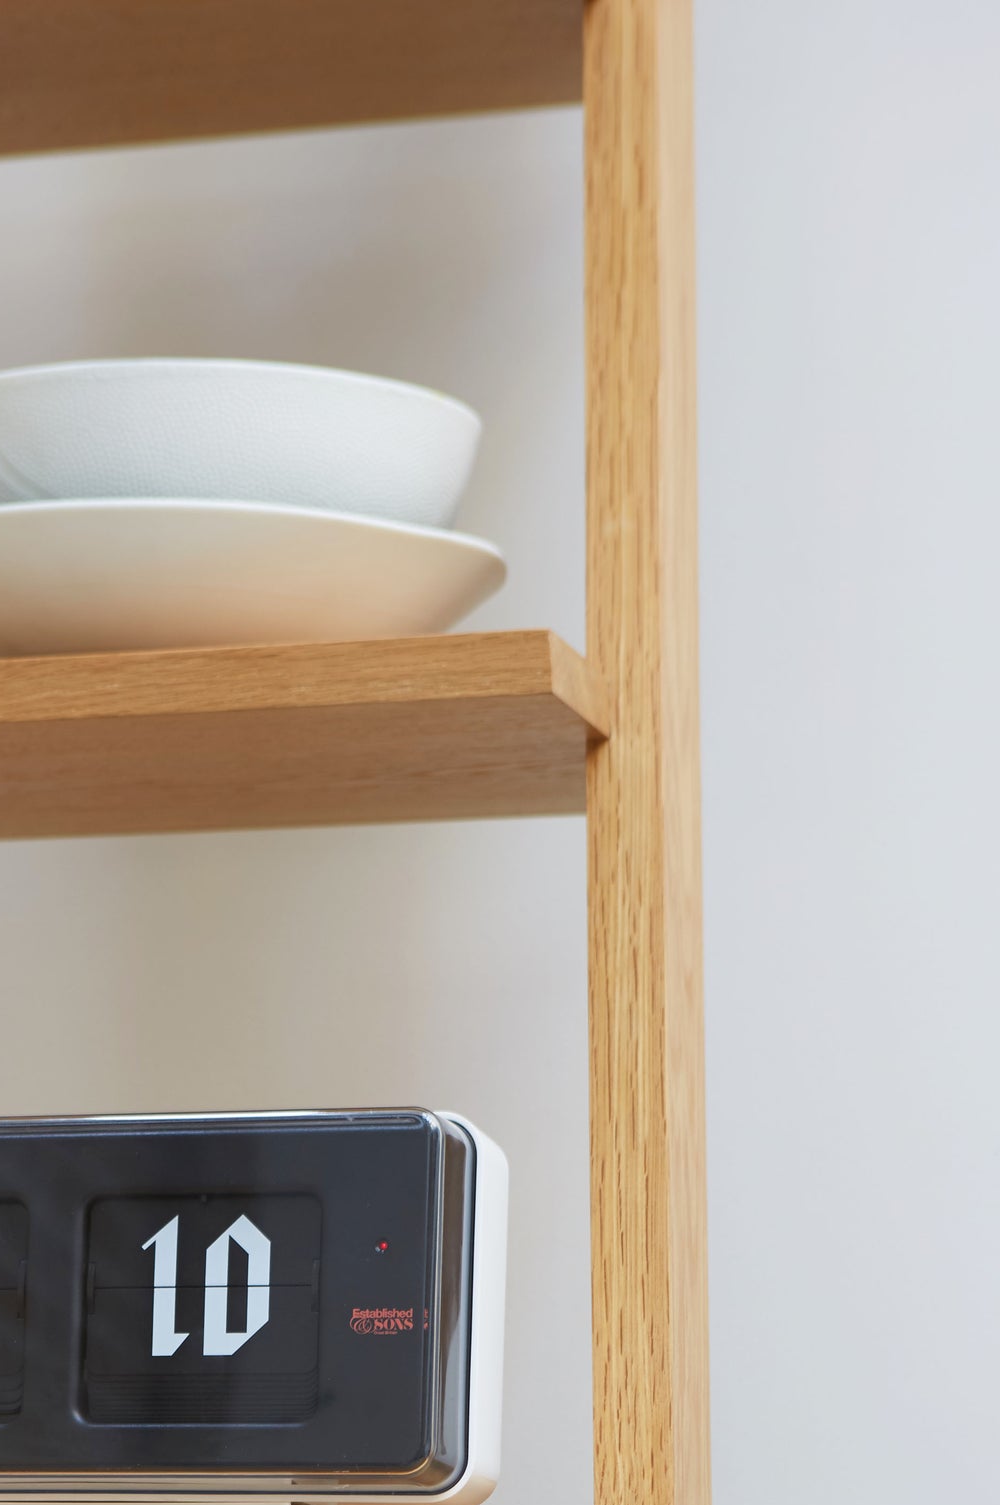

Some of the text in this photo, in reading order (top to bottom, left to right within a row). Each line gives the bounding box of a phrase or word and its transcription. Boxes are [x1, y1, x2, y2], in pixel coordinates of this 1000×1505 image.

[141, 1214, 272, 1358] 10
[352, 1308, 414, 1319] Established
[375, 1318, 414, 1331] SONS
